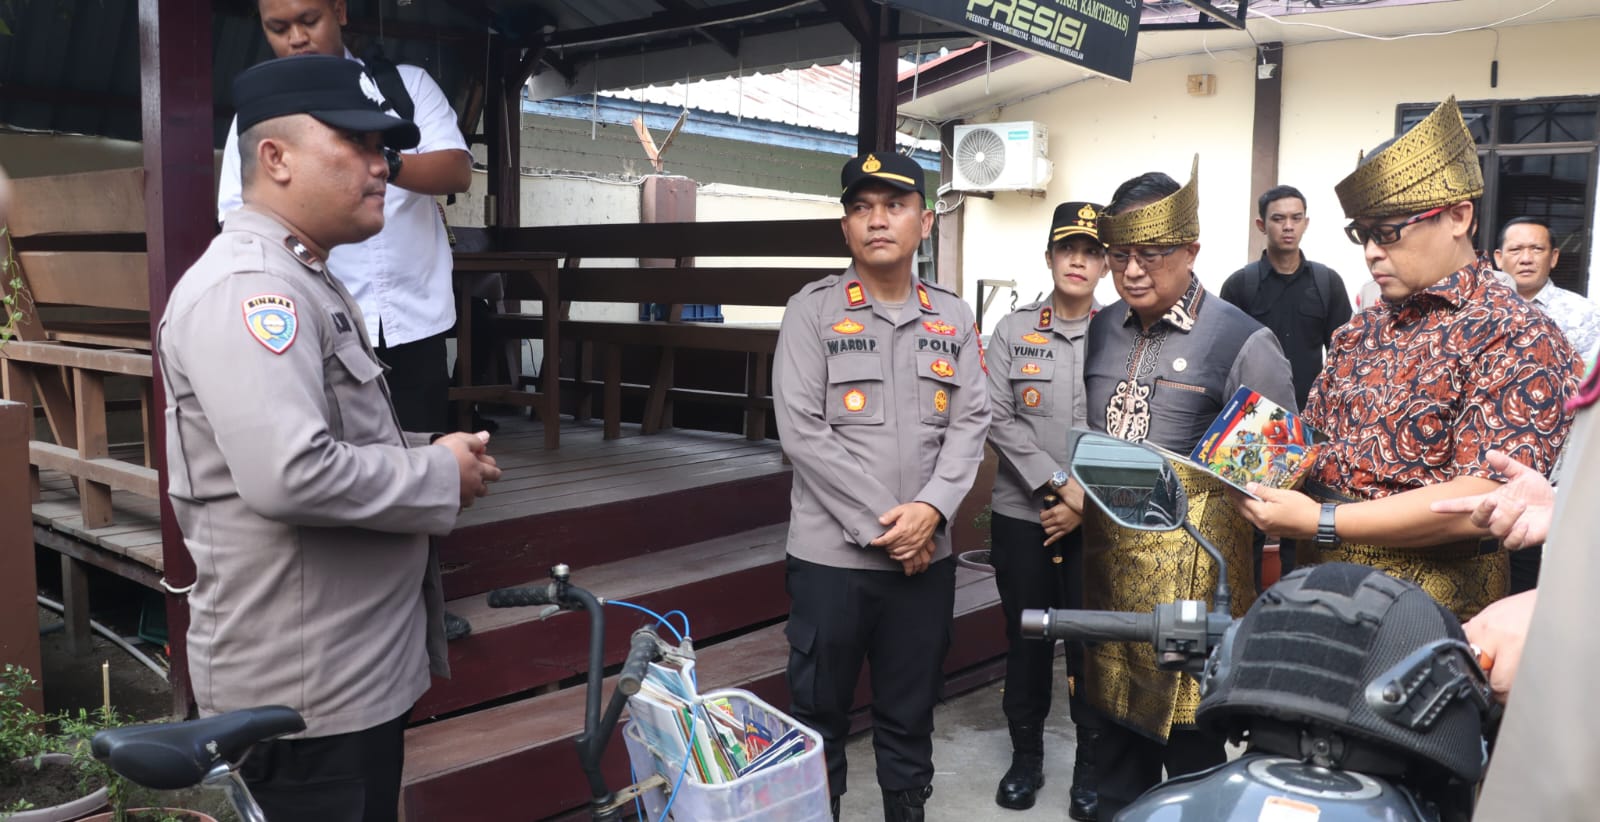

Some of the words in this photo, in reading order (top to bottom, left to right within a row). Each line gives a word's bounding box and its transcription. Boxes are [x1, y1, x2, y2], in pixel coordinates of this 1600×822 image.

[827, 338, 867, 355] WARDI
[869, 339, 876, 351] P
[1014, 345, 1054, 359] YUNITA
